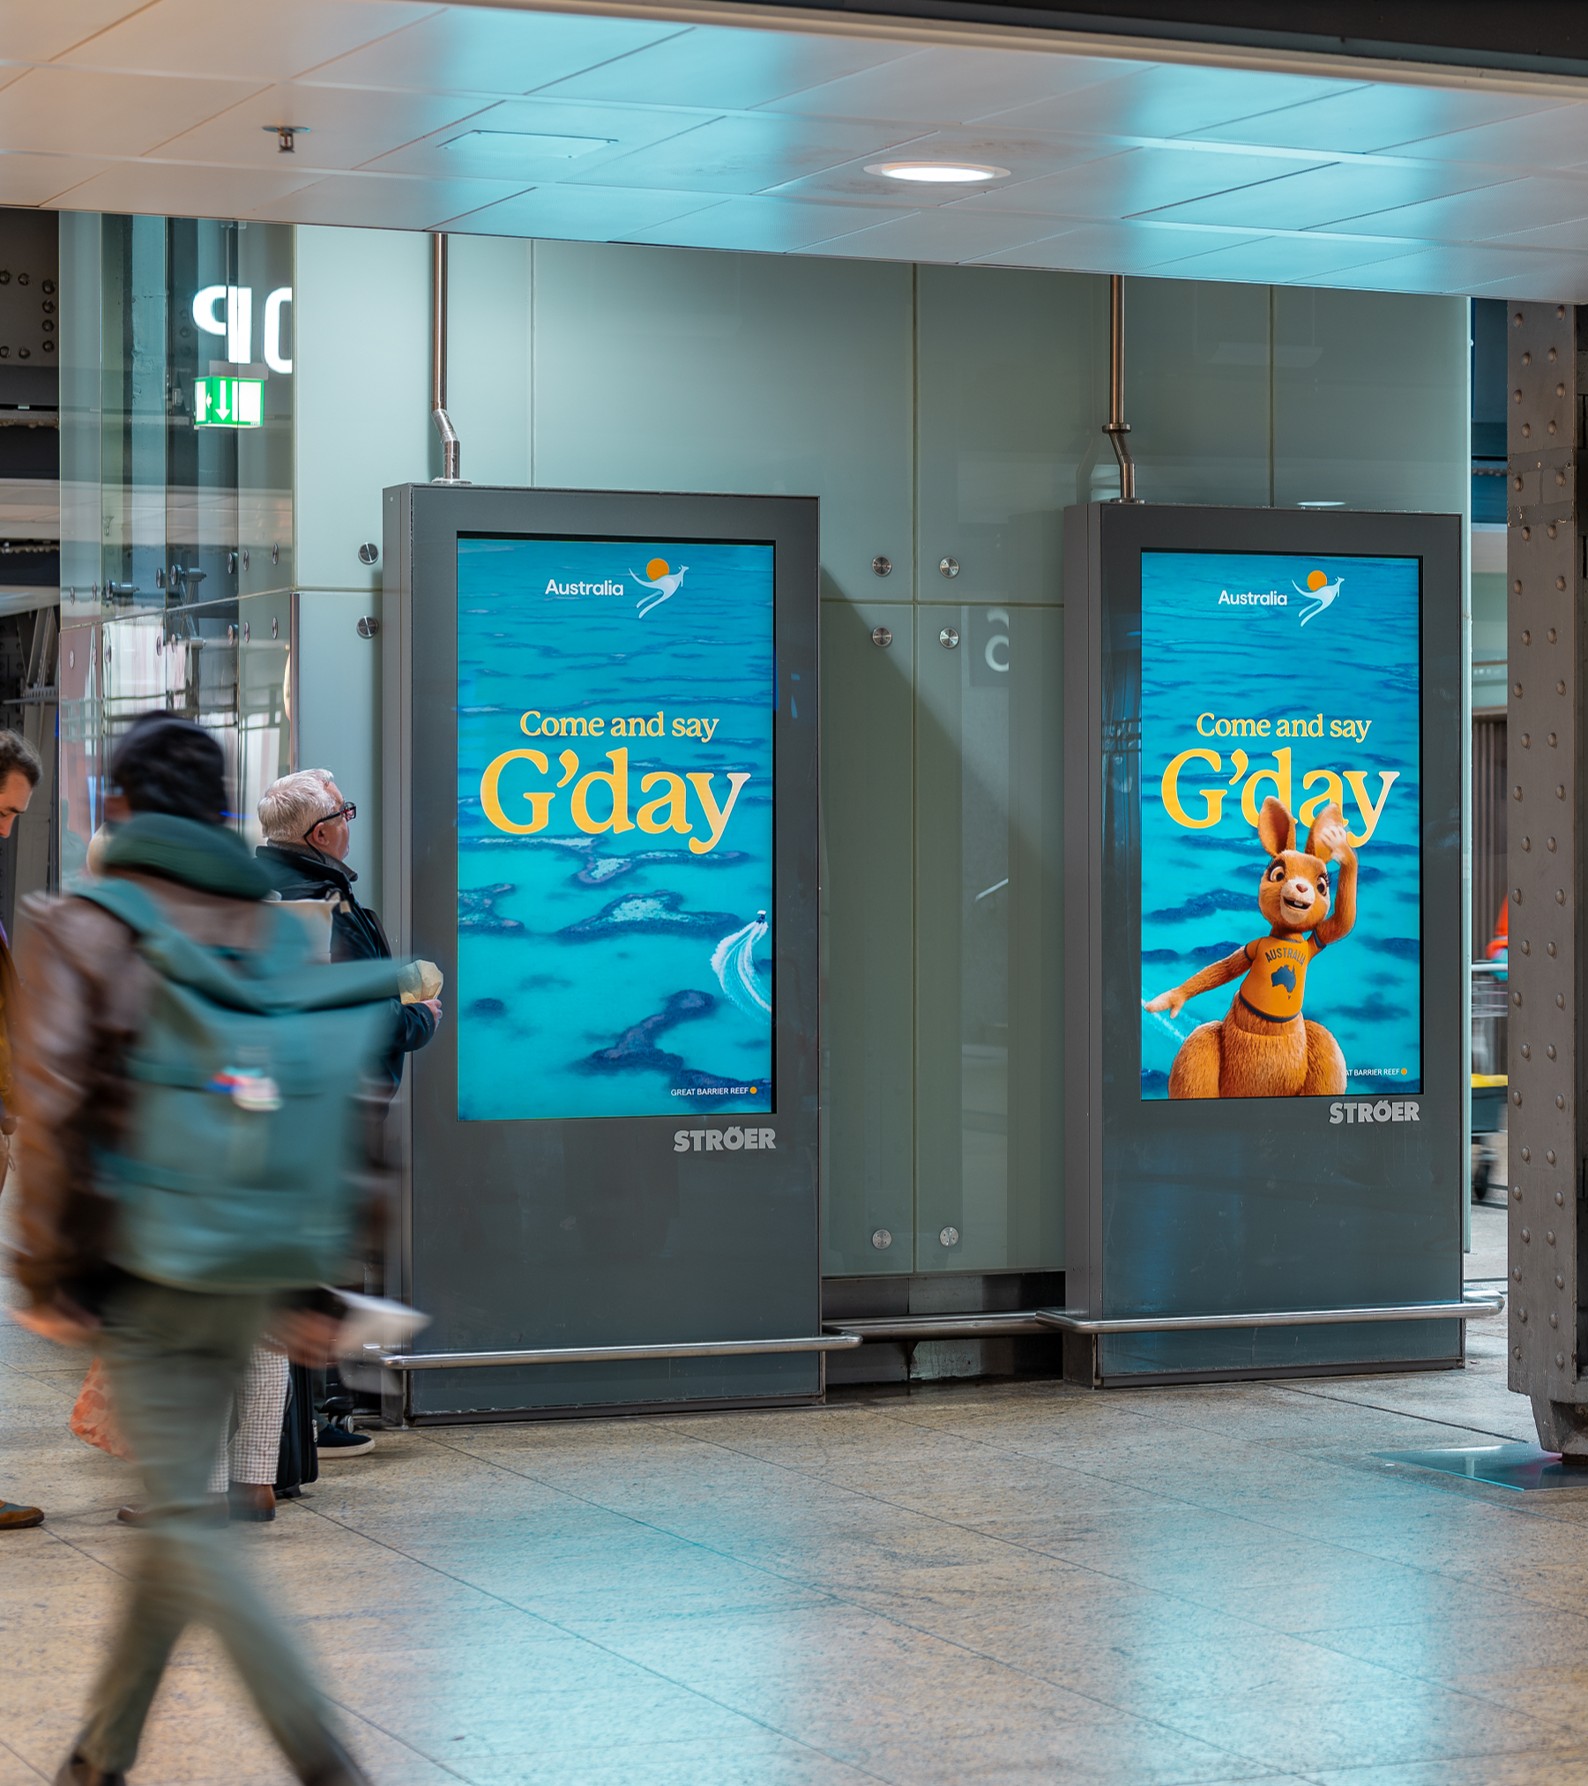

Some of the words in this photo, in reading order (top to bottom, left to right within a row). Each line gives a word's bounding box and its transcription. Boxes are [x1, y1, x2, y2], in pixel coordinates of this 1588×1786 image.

[544, 579, 624, 597] Australia
[1218, 590, 1288, 606] Australia
[520, 711, 605, 737] Come
[611, 711, 665, 737] and
[672, 717, 720, 743] say
[1196, 712, 1271, 737] Come
[1276, 713, 1325, 738] and
[1330, 719, 1372, 743] say
[1265, 947, 1306, 966] AUSTRALIA
[1354, 1068, 1382, 1076] BARRIER
[671, 1088, 696, 1096] GREAT
[696, 1087, 729, 1095] BARRIER
[1329, 1100, 1420, 1124] STRÖER
[673, 1126, 776, 1152] STRÖER
